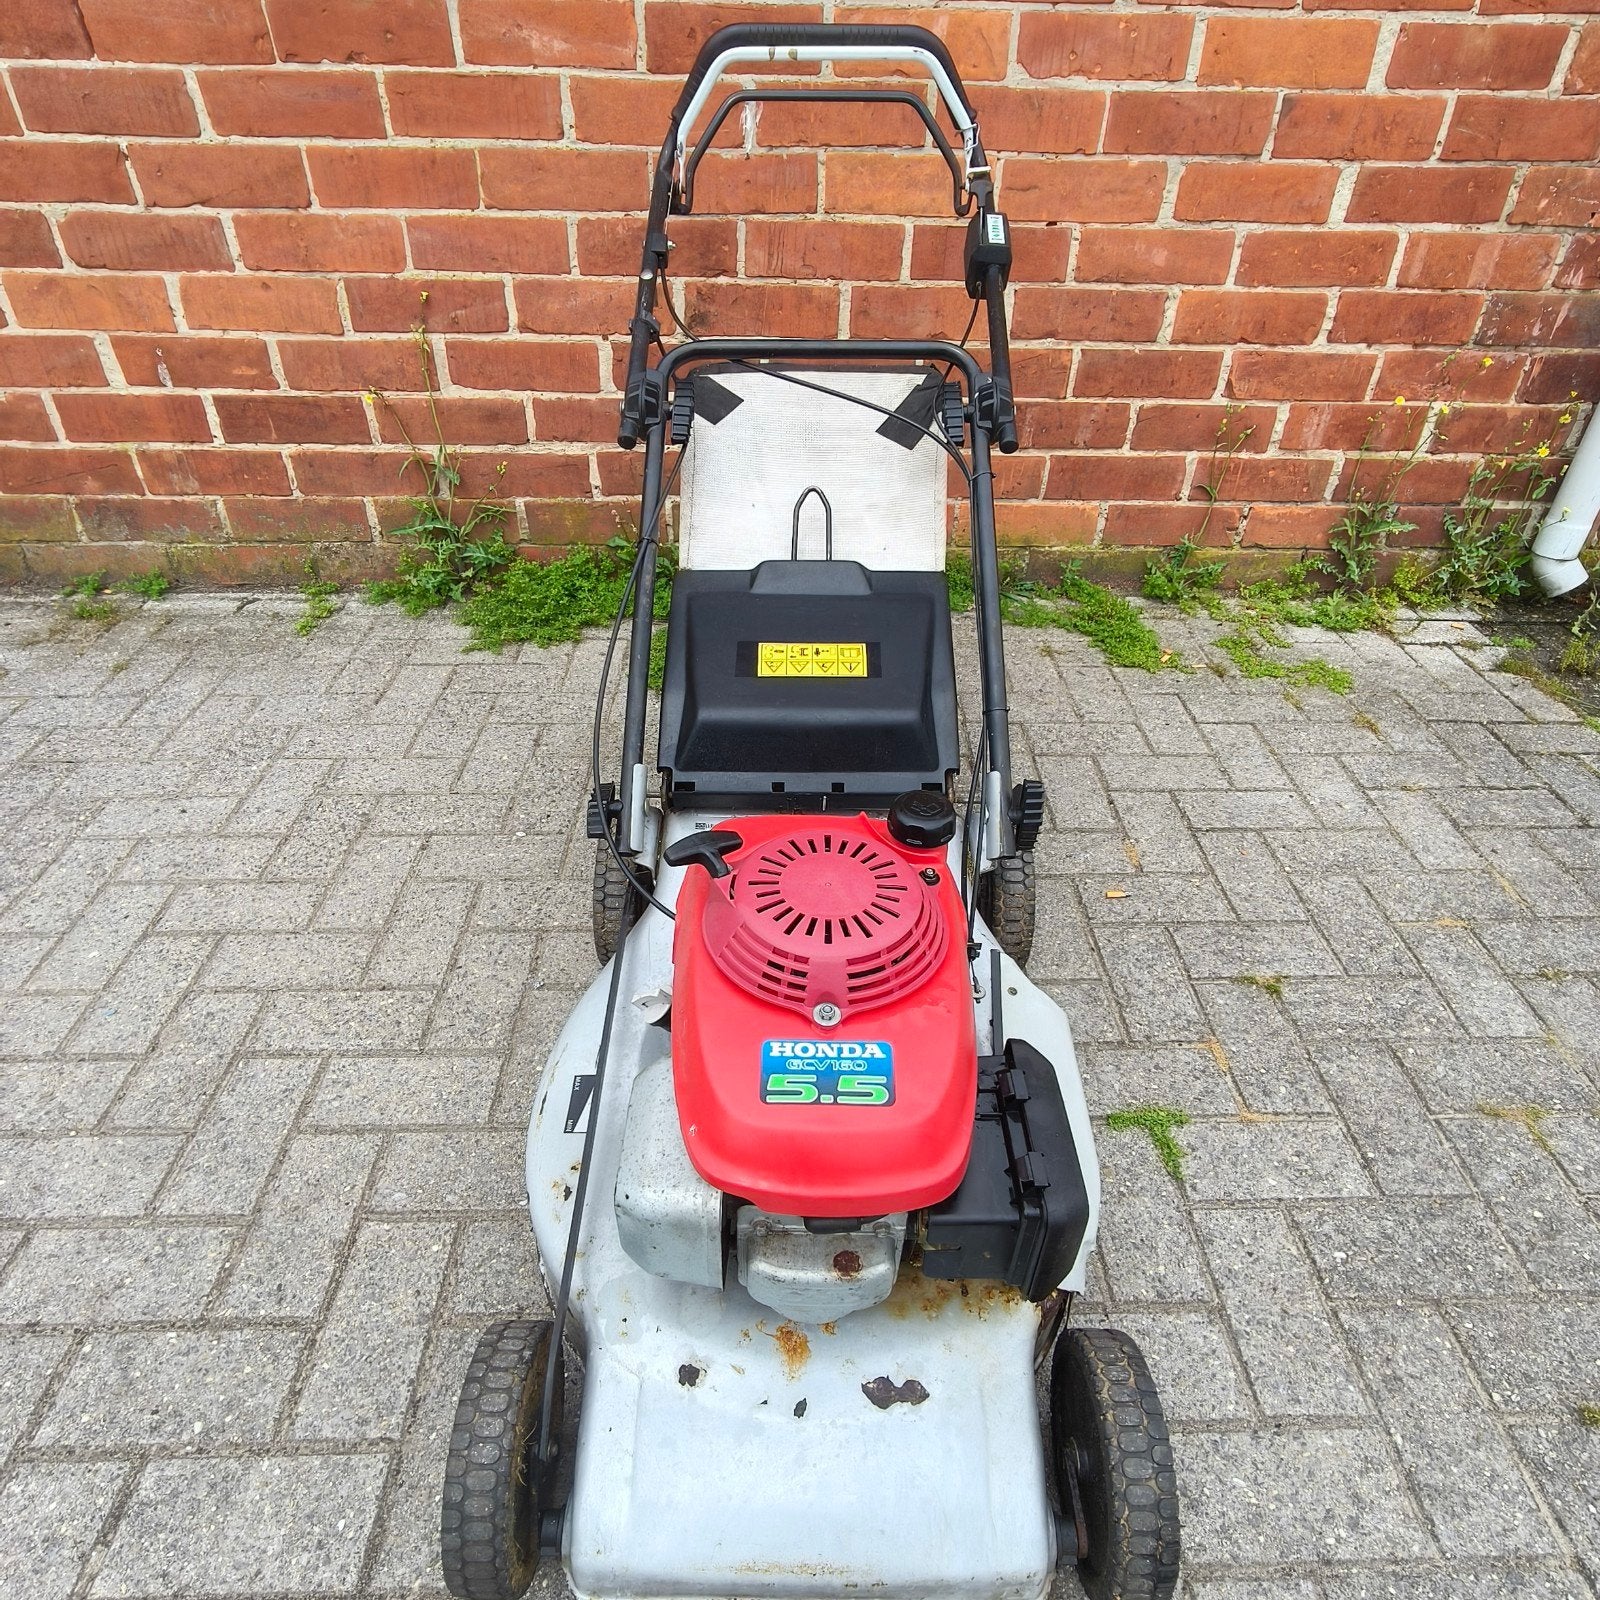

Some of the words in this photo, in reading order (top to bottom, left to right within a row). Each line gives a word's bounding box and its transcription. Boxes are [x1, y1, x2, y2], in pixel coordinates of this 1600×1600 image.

[769, 1041, 887, 1059] HONDA
[785, 1059, 868, 1072] GCV160
[573, 1076, 582, 1091] MAX
[765, 1073, 890, 1105] 5.5
[565, 1119, 574, 1132] MIN
